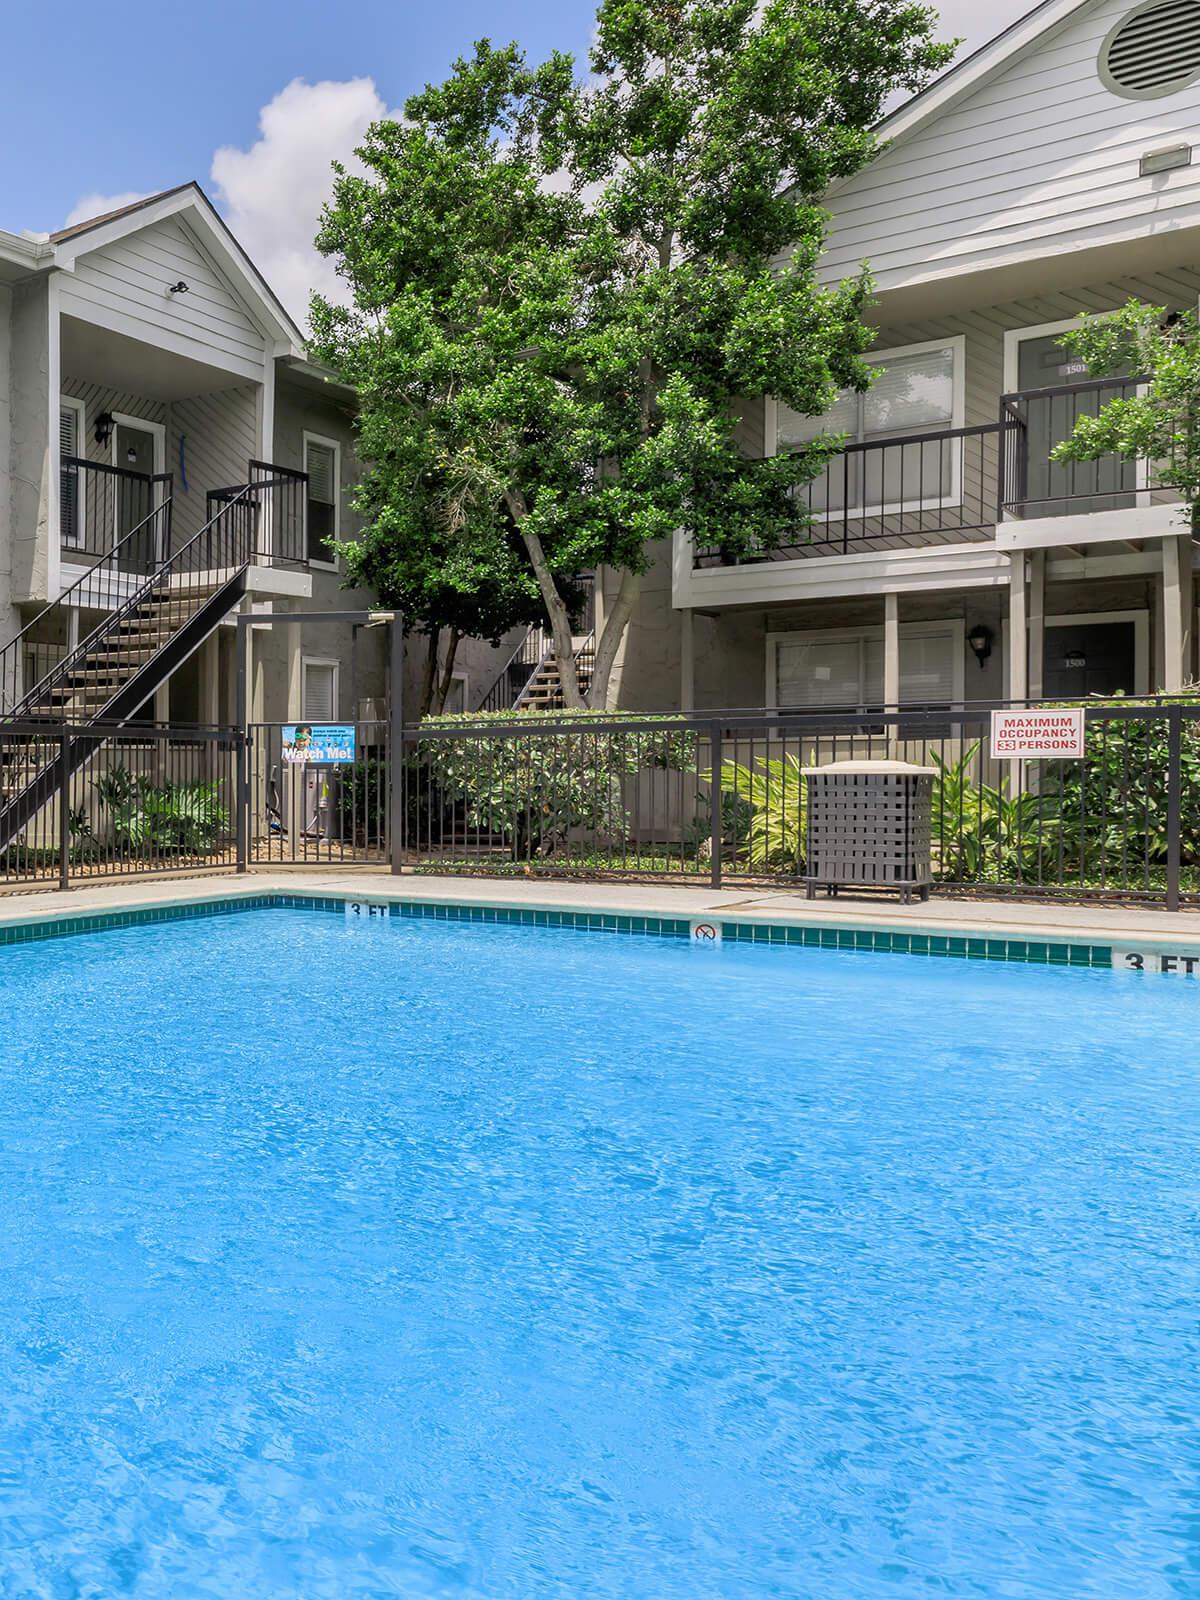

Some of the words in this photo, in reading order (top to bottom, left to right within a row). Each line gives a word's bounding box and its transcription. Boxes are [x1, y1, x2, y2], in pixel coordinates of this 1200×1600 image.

[1004, 718, 1072, 728] MAXIMUM
[999, 728, 1076, 738] OCCUPANCY
[1019, 740, 1077, 749] PERSONS
[282, 747, 324, 759] Watch
[327, 747, 352, 759] Me!
[351, 903, 361, 915] 3
[369, 904, 387, 916] FT
[1125, 953, 1144, 970] 3
[1161, 955, 1200, 973] FT
